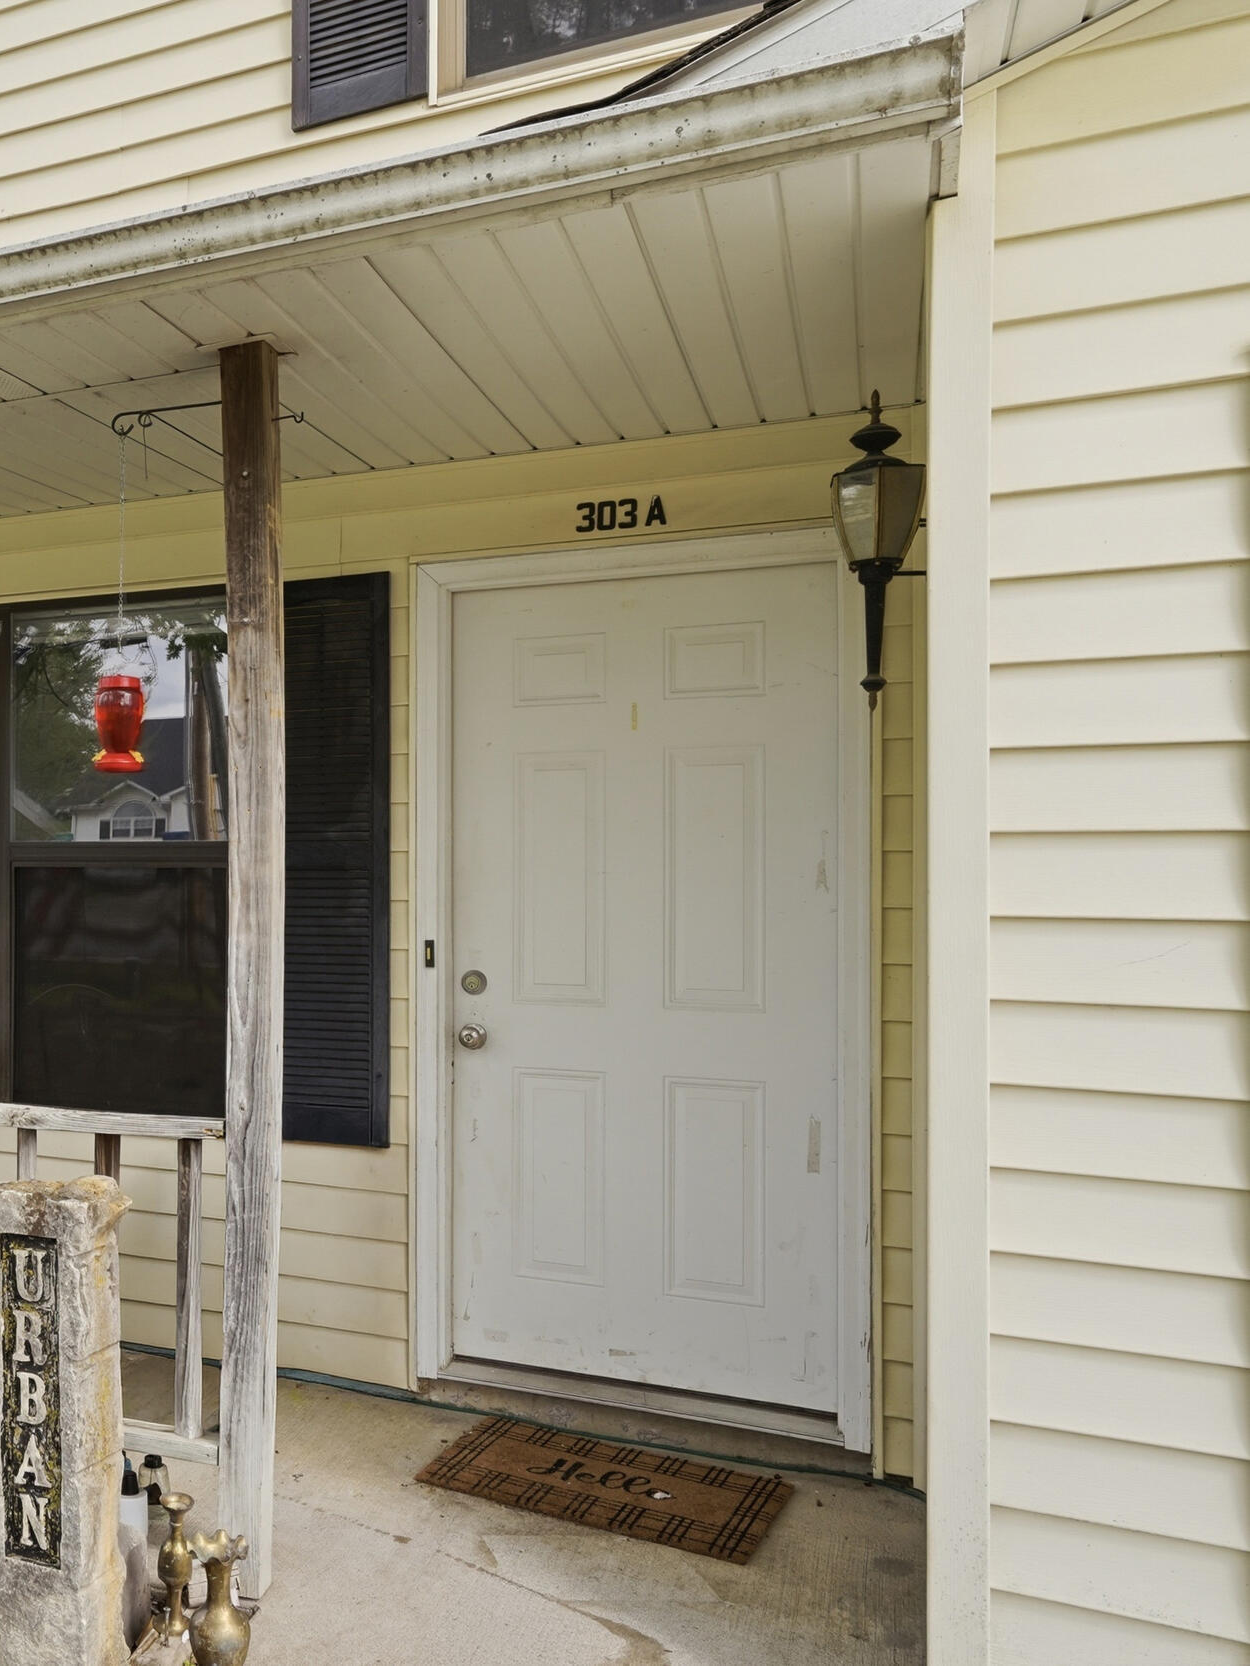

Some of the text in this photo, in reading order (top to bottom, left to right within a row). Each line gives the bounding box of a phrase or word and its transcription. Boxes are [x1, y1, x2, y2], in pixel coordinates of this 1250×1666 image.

[575, 494, 667, 533] 303 A
[13, 1248, 52, 1551] URBAN
[525, 1457, 677, 1500] Hello
